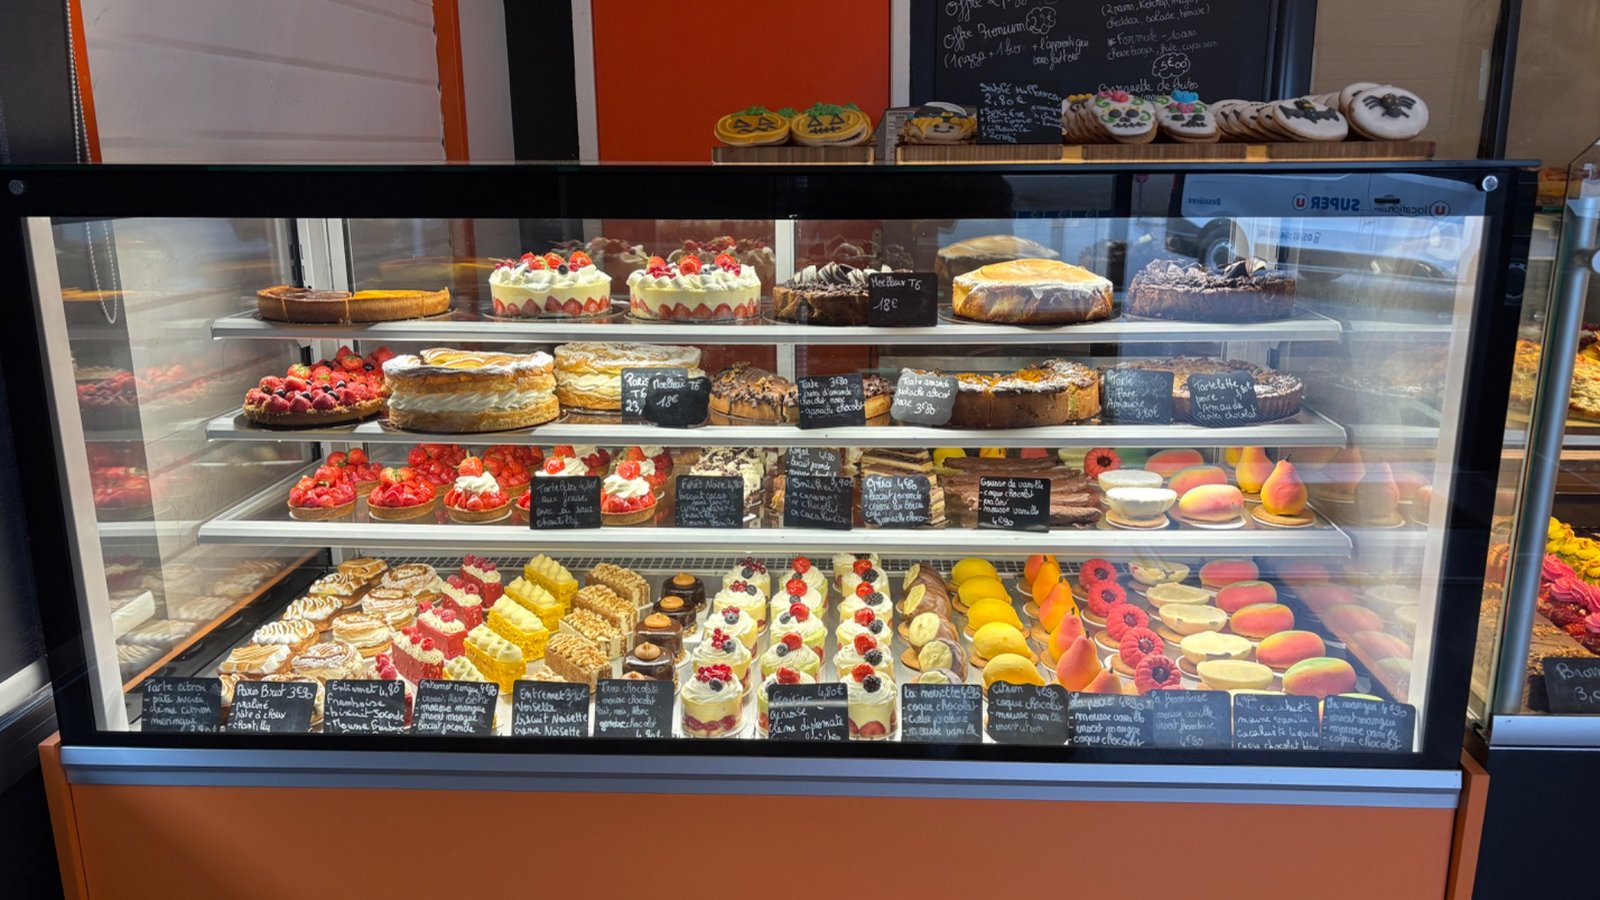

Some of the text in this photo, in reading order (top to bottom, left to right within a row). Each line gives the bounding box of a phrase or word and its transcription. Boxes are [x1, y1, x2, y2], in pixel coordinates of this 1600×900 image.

[1157, 79, 1171, 91] de
[908, 279, 922, 290] T6
[873, 297, 898, 311] 18€
[624, 373, 649, 387] Paris
[688, 380, 704, 391] T6
[799, 378, 819, 389] Tarte
[901, 375, 950, 389] Tarte amande
[1193, 378, 1239, 393] Tartelette
[631, 388, 648, 398] T6
[897, 387, 951, 399] pistache abricot
[1116, 388, 1138, 398] Poire
[656, 394, 680, 408] 18€
[805, 399, 865, 418] ganache chocolat
[1225, 404, 1257, 419] chocolat
[980, 477, 1044, 490] Gousse de vanille
[983, 488, 1034, 499] coque chocolat
[983, 505, 1041, 515] mousse vanille
[144, 679, 207, 693] Tarte citron
[236, 684, 314, 699] Paris Brest 3€90
[817, 685, 844, 700] 4,80€
[904, 686, 916, 698] La
[920, 685, 961, 698] noisette
[992, 682, 1059, 699] Citron 4€90
[152, 692, 205, 706] pâte sucrée
[326, 693, 386, 707] Framboise
[520, 688, 565, 701] Entremet
[627, 694, 656, 706] chocolat
[180, 705, 212, 717] citron
[236, 698, 270, 712] praliné
[420, 704, 486, 715] mousse mangue
[515, 701, 557, 713] Noisette
[907, 699, 979, 716] coque chocolat
[995, 697, 1064, 711] coque chocolat
[1342, 701, 1408, 718] mangue 4€90
[235, 709, 287, 721] pâte à choux
[330, 706, 373, 718] biscuit
[514, 712, 588, 726] biscuit Noisette
[995, 711, 1064, 723] mousse vanille
[1075, 710, 1144, 723] mousse vanille
[1273, 714, 1310, 724] vanille
[150, 717, 198, 732] meringue
[232, 719, 272, 733] chantilly
[332, 718, 370, 730] Mousse
[446, 714, 479, 725] mangue
[769, 713, 845, 738] crème diplomate
[1329, 711, 1397, 731] insert mangue
[418, 720, 475, 735] biscuit joconde
[545, 725, 581, 737] Noisette
[946, 723, 981, 738] vanille
[1076, 721, 1140, 739] insert mangue
[1289, 727, 1319, 741] liquide
[1329, 724, 1401, 743] mousse vanille
[1073, 733, 1146, 747] coque chocolat
[1180, 735, 1203, 747] 4€90
[1329, 735, 1403, 751] coque chocolat
